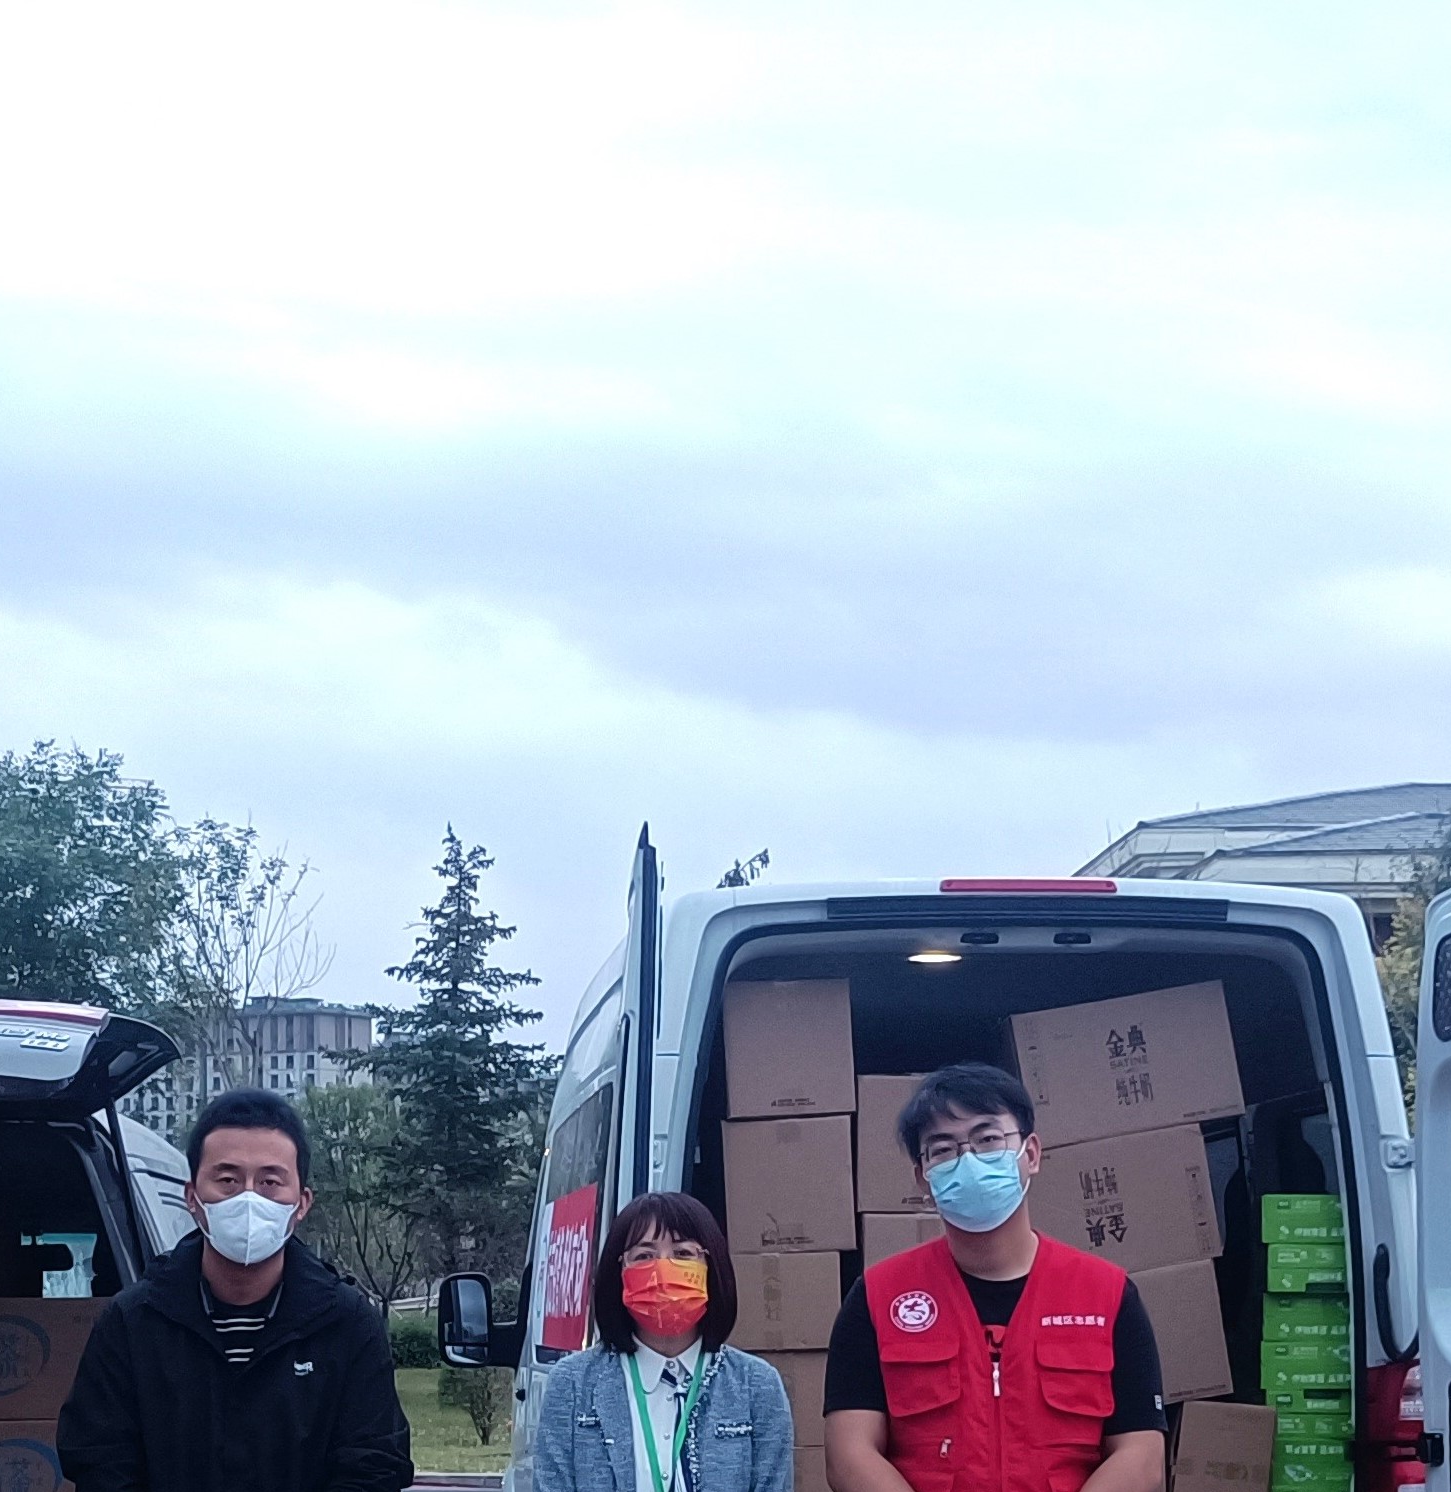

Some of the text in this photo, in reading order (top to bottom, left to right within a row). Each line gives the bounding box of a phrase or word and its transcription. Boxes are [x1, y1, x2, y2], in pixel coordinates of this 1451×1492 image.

[1105, 1024, 1147, 1059] 金典
[1115, 1072, 1155, 1106] 纯牛奶
[1085, 1212, 1129, 1247] 金典
